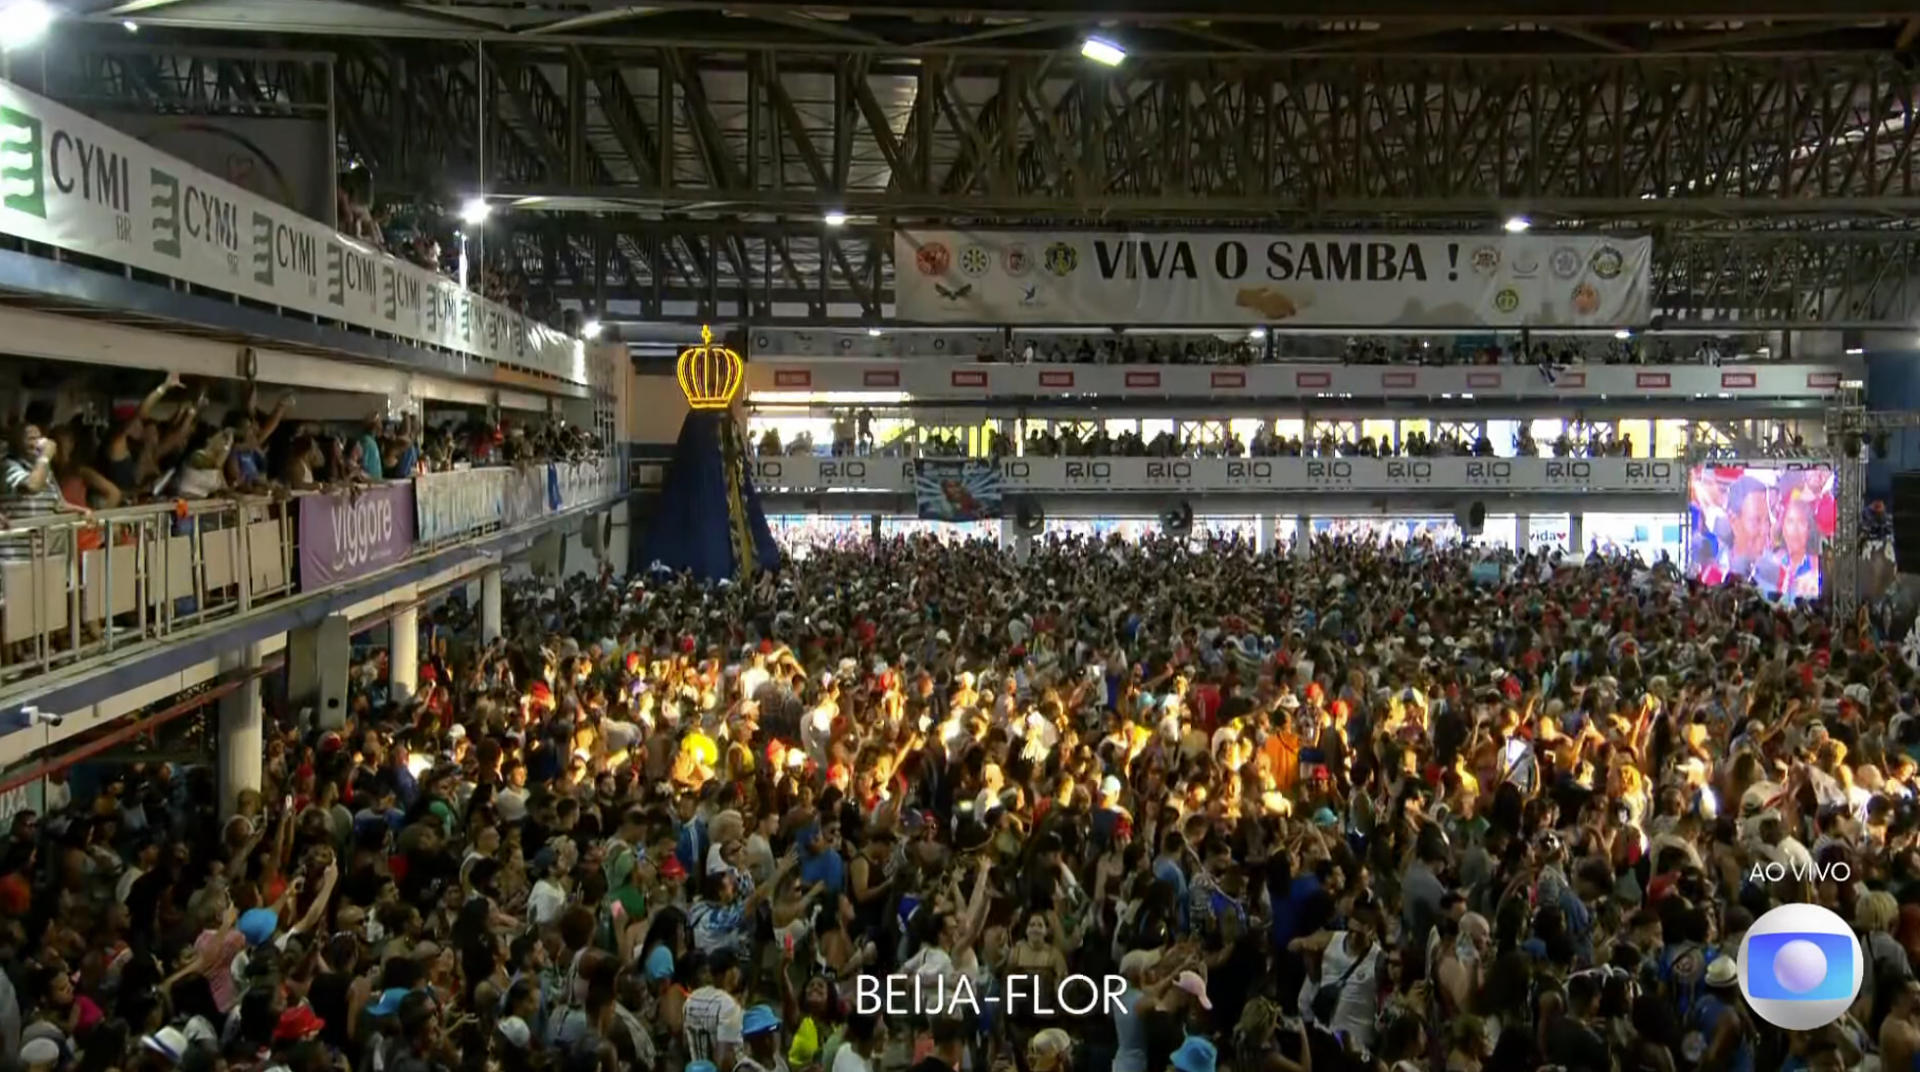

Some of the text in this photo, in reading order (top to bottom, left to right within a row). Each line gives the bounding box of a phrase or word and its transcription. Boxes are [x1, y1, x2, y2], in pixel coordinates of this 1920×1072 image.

[50, 130, 130, 213] CYMI
[184, 186, 238, 251] CYMI
[116, 215, 132, 242] BR
[276, 223, 317, 277] CYMI
[1093, 240, 1460, 282] VIVA O SAMBA !
[345, 252, 377, 298] CYMI
[750, 461, 782, 477] IO
[819, 461, 866, 478] RIO
[1000, 461, 1030, 478] IO
[1065, 461, 1110, 478] RIO
[1147, 461, 1192, 478] RIO
[1227, 461, 1272, 478] RIO
[1307, 461, 1351, 478] RIO
[1387, 461, 1431, 478] RIO
[1466, 461, 1511, 478] RIO
[1546, 461, 1591, 478] RIO
[1626, 461, 1671, 478] RIO
